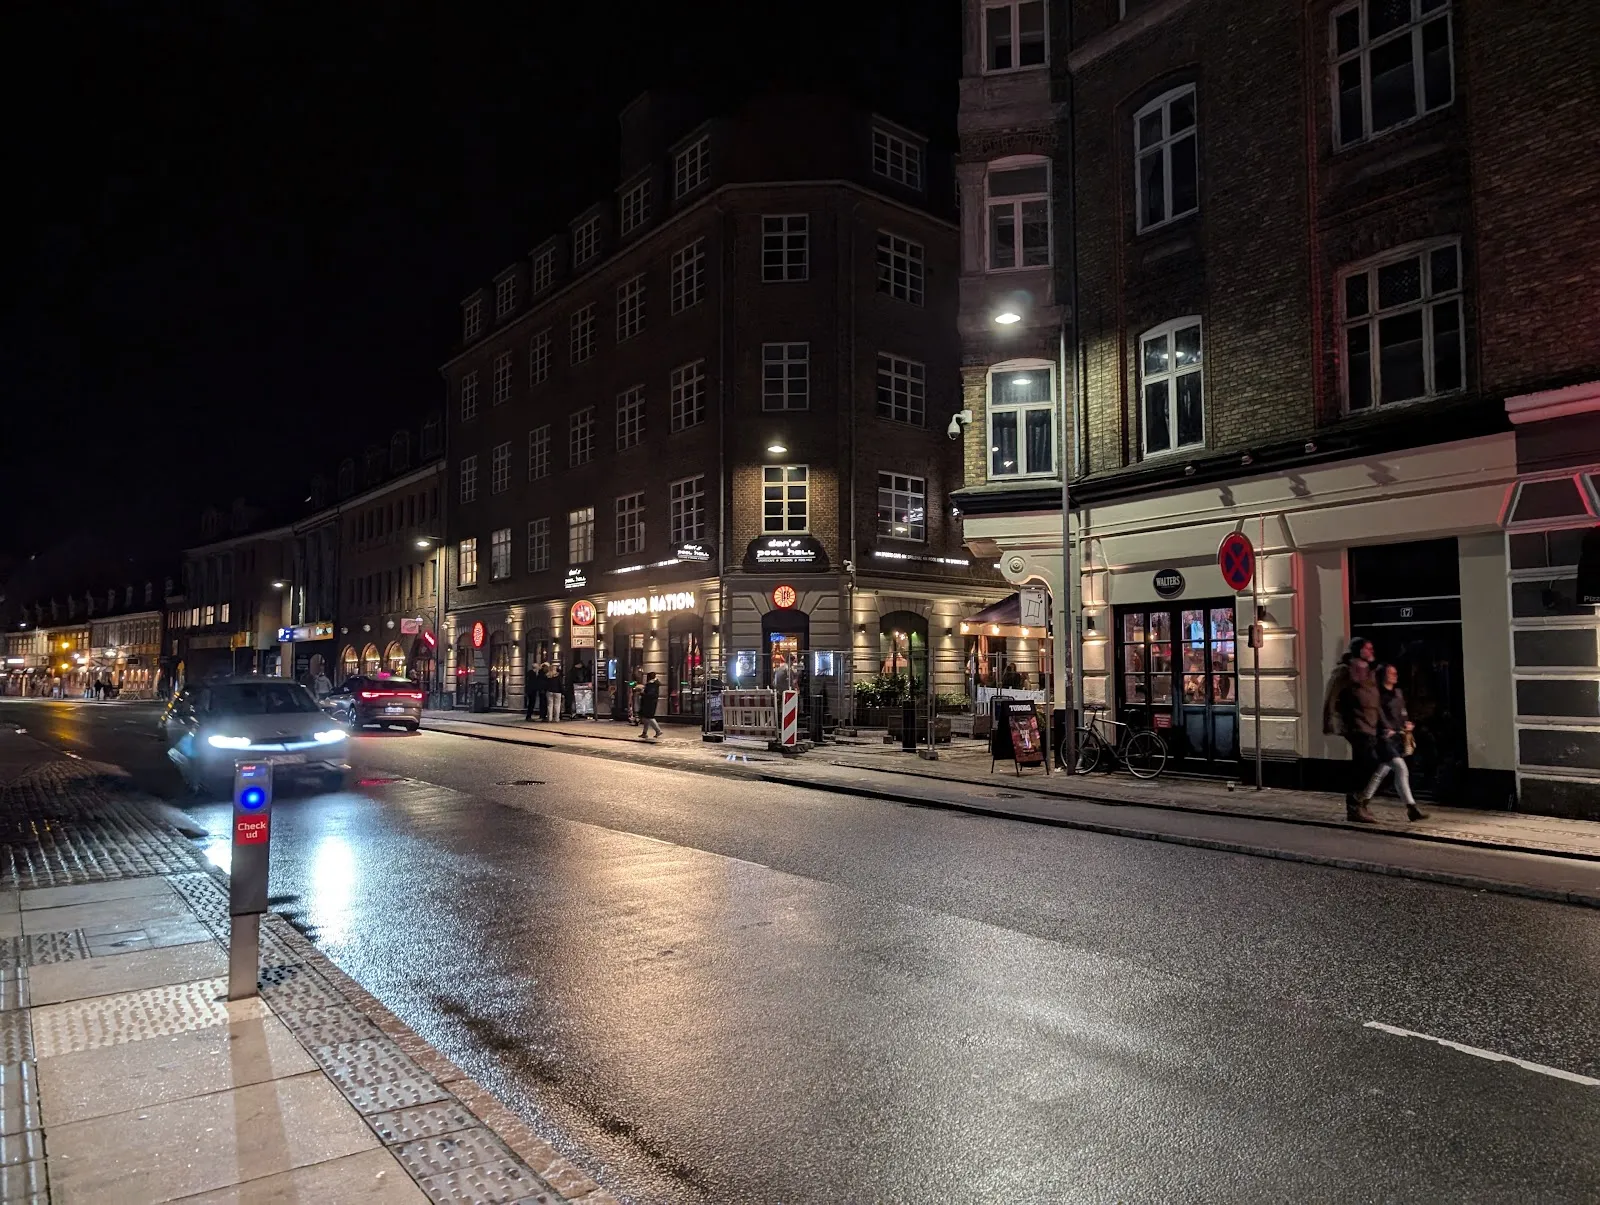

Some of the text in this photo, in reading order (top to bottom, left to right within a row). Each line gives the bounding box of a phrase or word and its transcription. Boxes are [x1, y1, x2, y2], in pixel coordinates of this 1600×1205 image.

[1155, 576, 1181, 587] WALTERS
[607, 597, 648, 617] PINCHO
[650, 592, 695, 613] NATION
[237, 821, 267, 831] Check
[245, 831, 258, 839] ud
